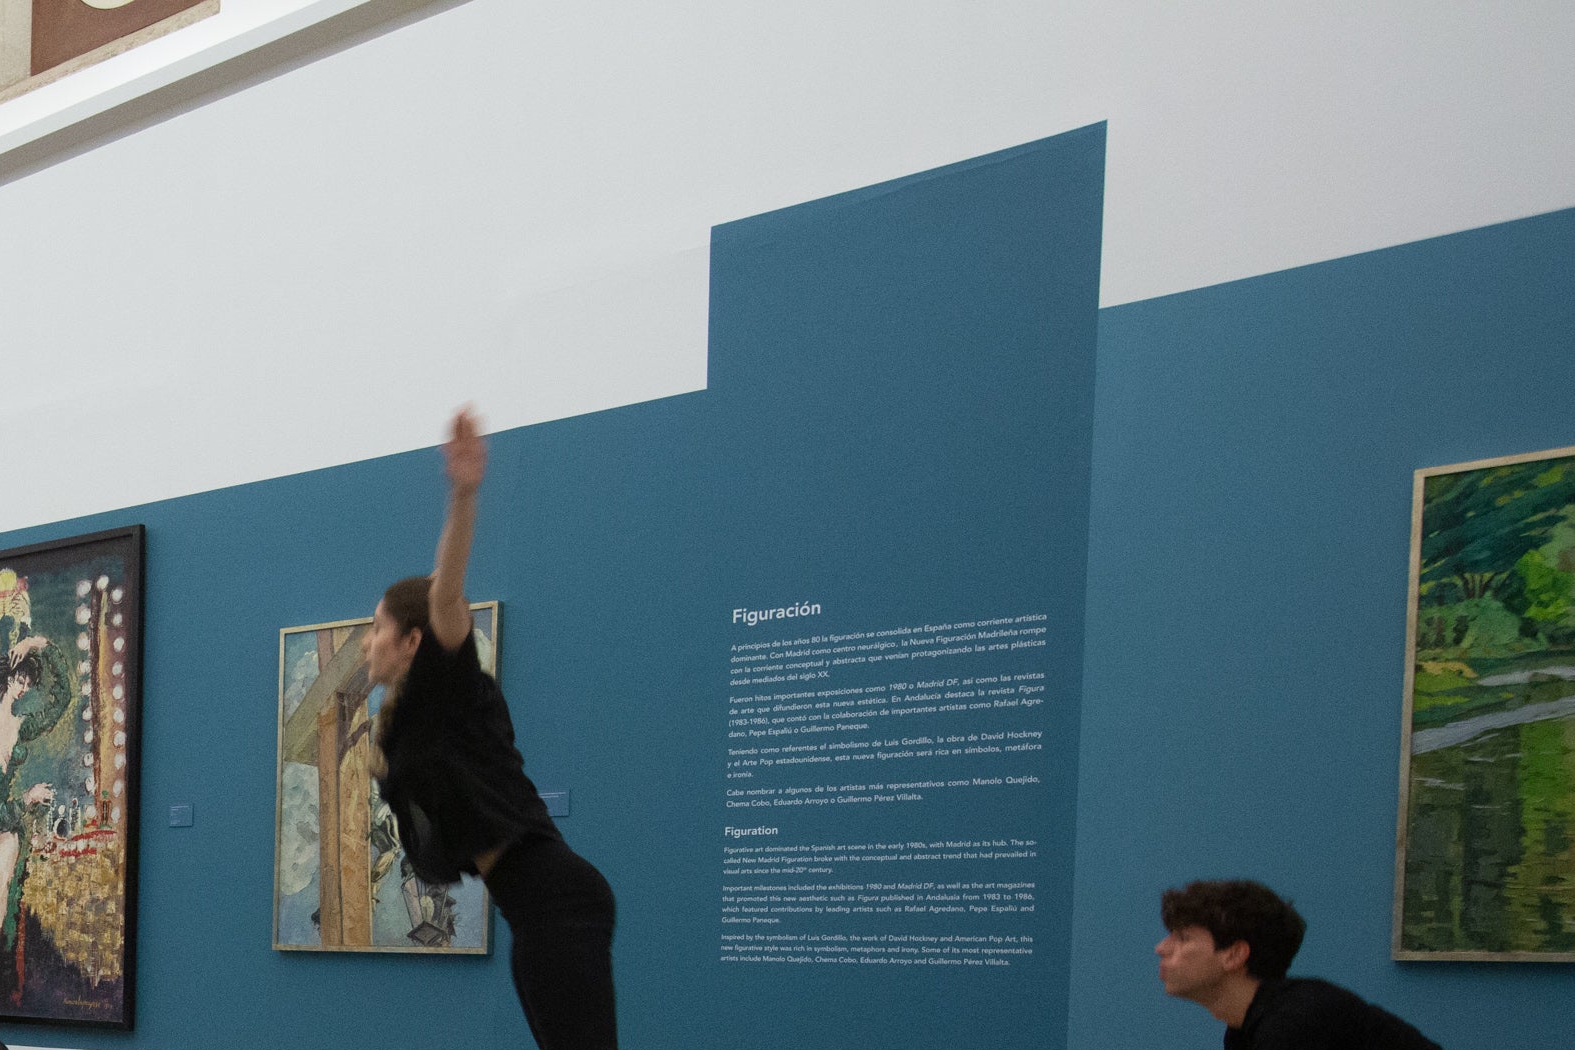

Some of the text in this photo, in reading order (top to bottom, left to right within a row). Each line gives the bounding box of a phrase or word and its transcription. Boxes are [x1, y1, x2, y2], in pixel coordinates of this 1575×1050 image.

[733, 600, 821, 627] Figuración
[738, 642, 770, 653] principios
[772, 640, 781, 648] de
[811, 636, 821, 644] 80
[876, 627, 912, 637] consolida
[977, 617, 1013, 627] corriente
[785, 649, 811, 658] Madrid
[833, 645, 856, 653] centro
[910, 638, 934, 646] Nueva
[1019, 627, 1047, 635] rompe
[753, 664, 783, 672] corriente
[786, 659, 824, 670] conceptual
[833, 656, 866, 665] abstracta
[868, 655, 883, 663] que
[911, 646, 973, 660] protagonizando
[988, 643, 1009, 651] artes
[729, 696, 753, 704] Fueron
[774, 691, 815, 701] importantes
[817, 687, 863, 698] exposiciones
[889, 682, 907, 691] 1980
[917, 679, 945, 688] Madrid
[975, 676, 998, 684] como
[1014, 672, 1045, 680] revistas
[730, 678, 751, 686] desde
[752, 675, 785, 684] mediados
[787, 673, 798, 681] del
[799, 672, 816, 681] siglo
[757, 707, 770, 715] que
[773, 703, 812, 712] difundieron
[815, 701, 830, 709] esta
[891, 695, 901, 703] En
[944, 690, 975, 698] destaca
[988, 687, 1015, 695] revista
[1018, 685, 1045, 694] Figura
[880, 708, 890, 716] de
[891, 706, 937, 716] importantes
[939, 703, 967, 711] artistas
[994, 698, 1019, 707] Rafael
[749, 730, 766, 738] Pepe
[800, 725, 835, 733] Guillermo
[728, 748, 758, 756] Teniendo
[782, 745, 818, 753] referentes
[829, 741, 869, 750] simbolismo
[981, 732, 1004, 740] David
[1007, 730, 1043, 739] Hockney
[760, 759, 774, 767] Pop
[747, 788, 776, 796] nombrar
[785, 787, 812, 796] algunos
[886, 780, 945, 791] representativos
[973, 777, 1003, 785] Manolo
[774, 798, 803, 806] Eduardo
[804, 798, 829, 806] Arroyo
[725, 825, 779, 839] Figuration
